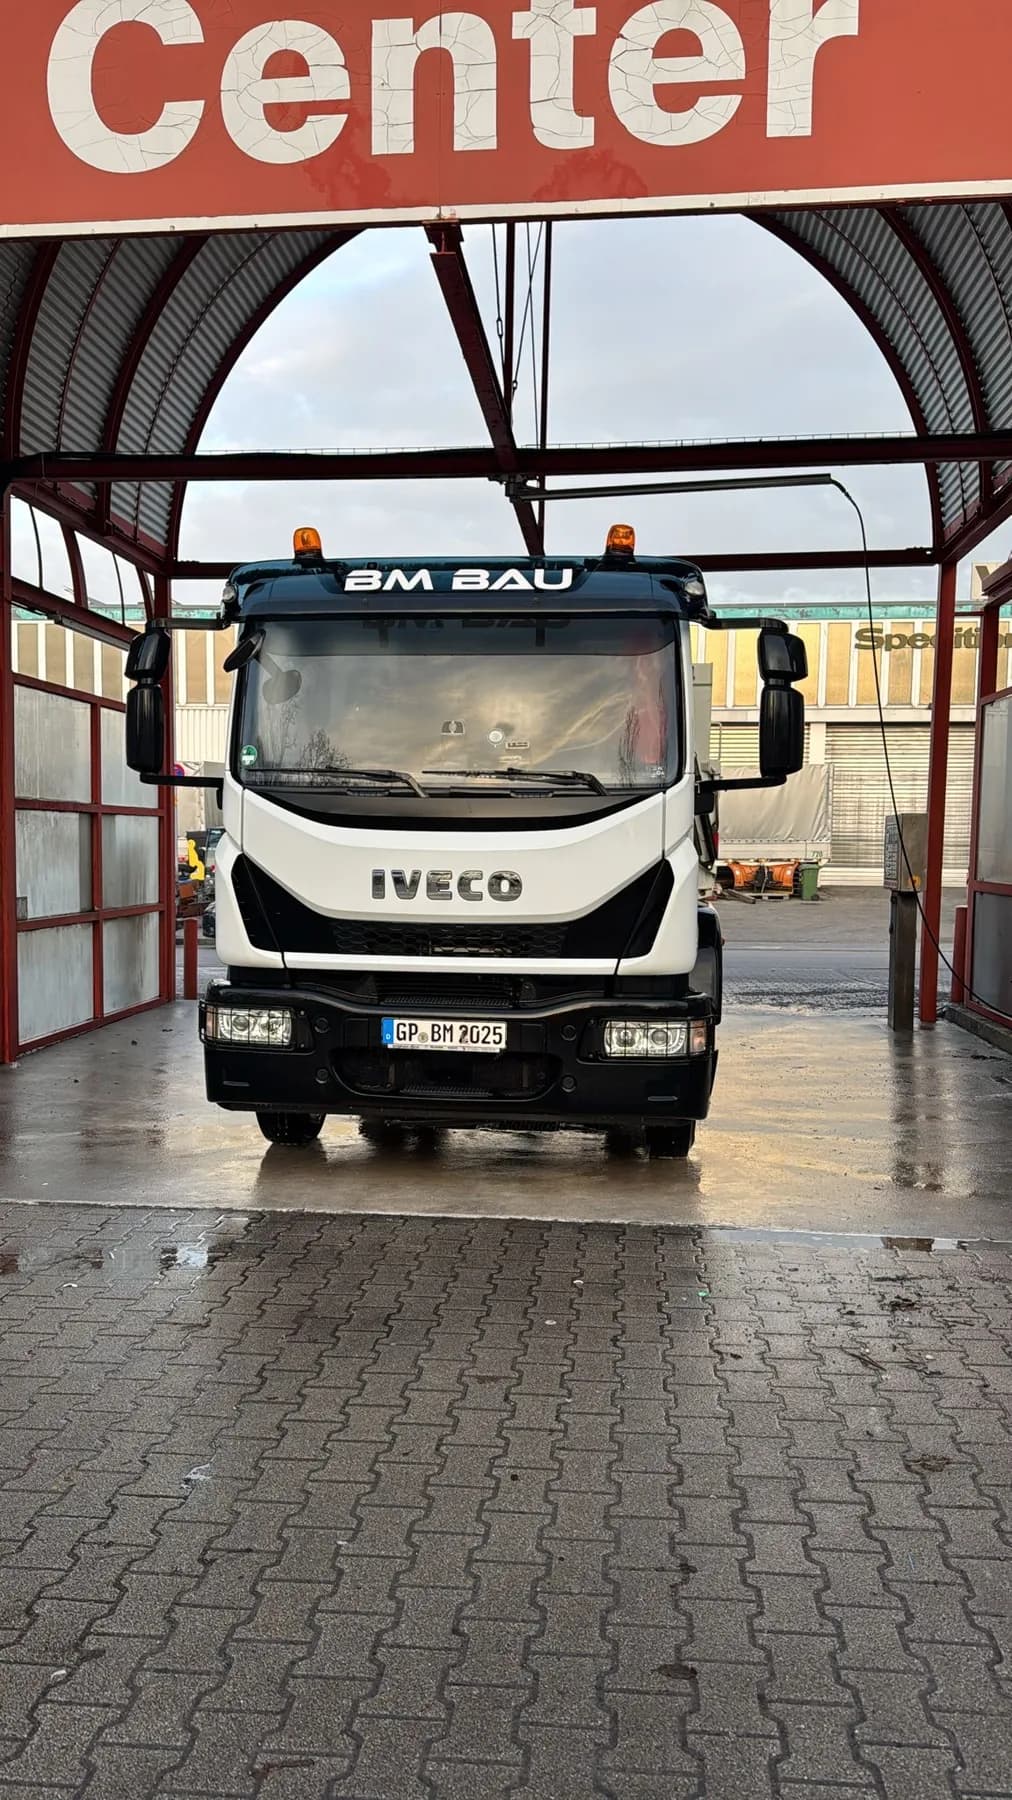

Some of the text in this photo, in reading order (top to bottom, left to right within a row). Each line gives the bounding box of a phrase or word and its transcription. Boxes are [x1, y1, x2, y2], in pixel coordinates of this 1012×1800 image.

[46, 0, 859, 173] Center
[344, 568, 573, 591] BM BAU
[855, 627, 1012, 651] Speiti
[371, 869, 523, 901] IVECO
[396, 1022, 503, 1045] GP BM 2025
